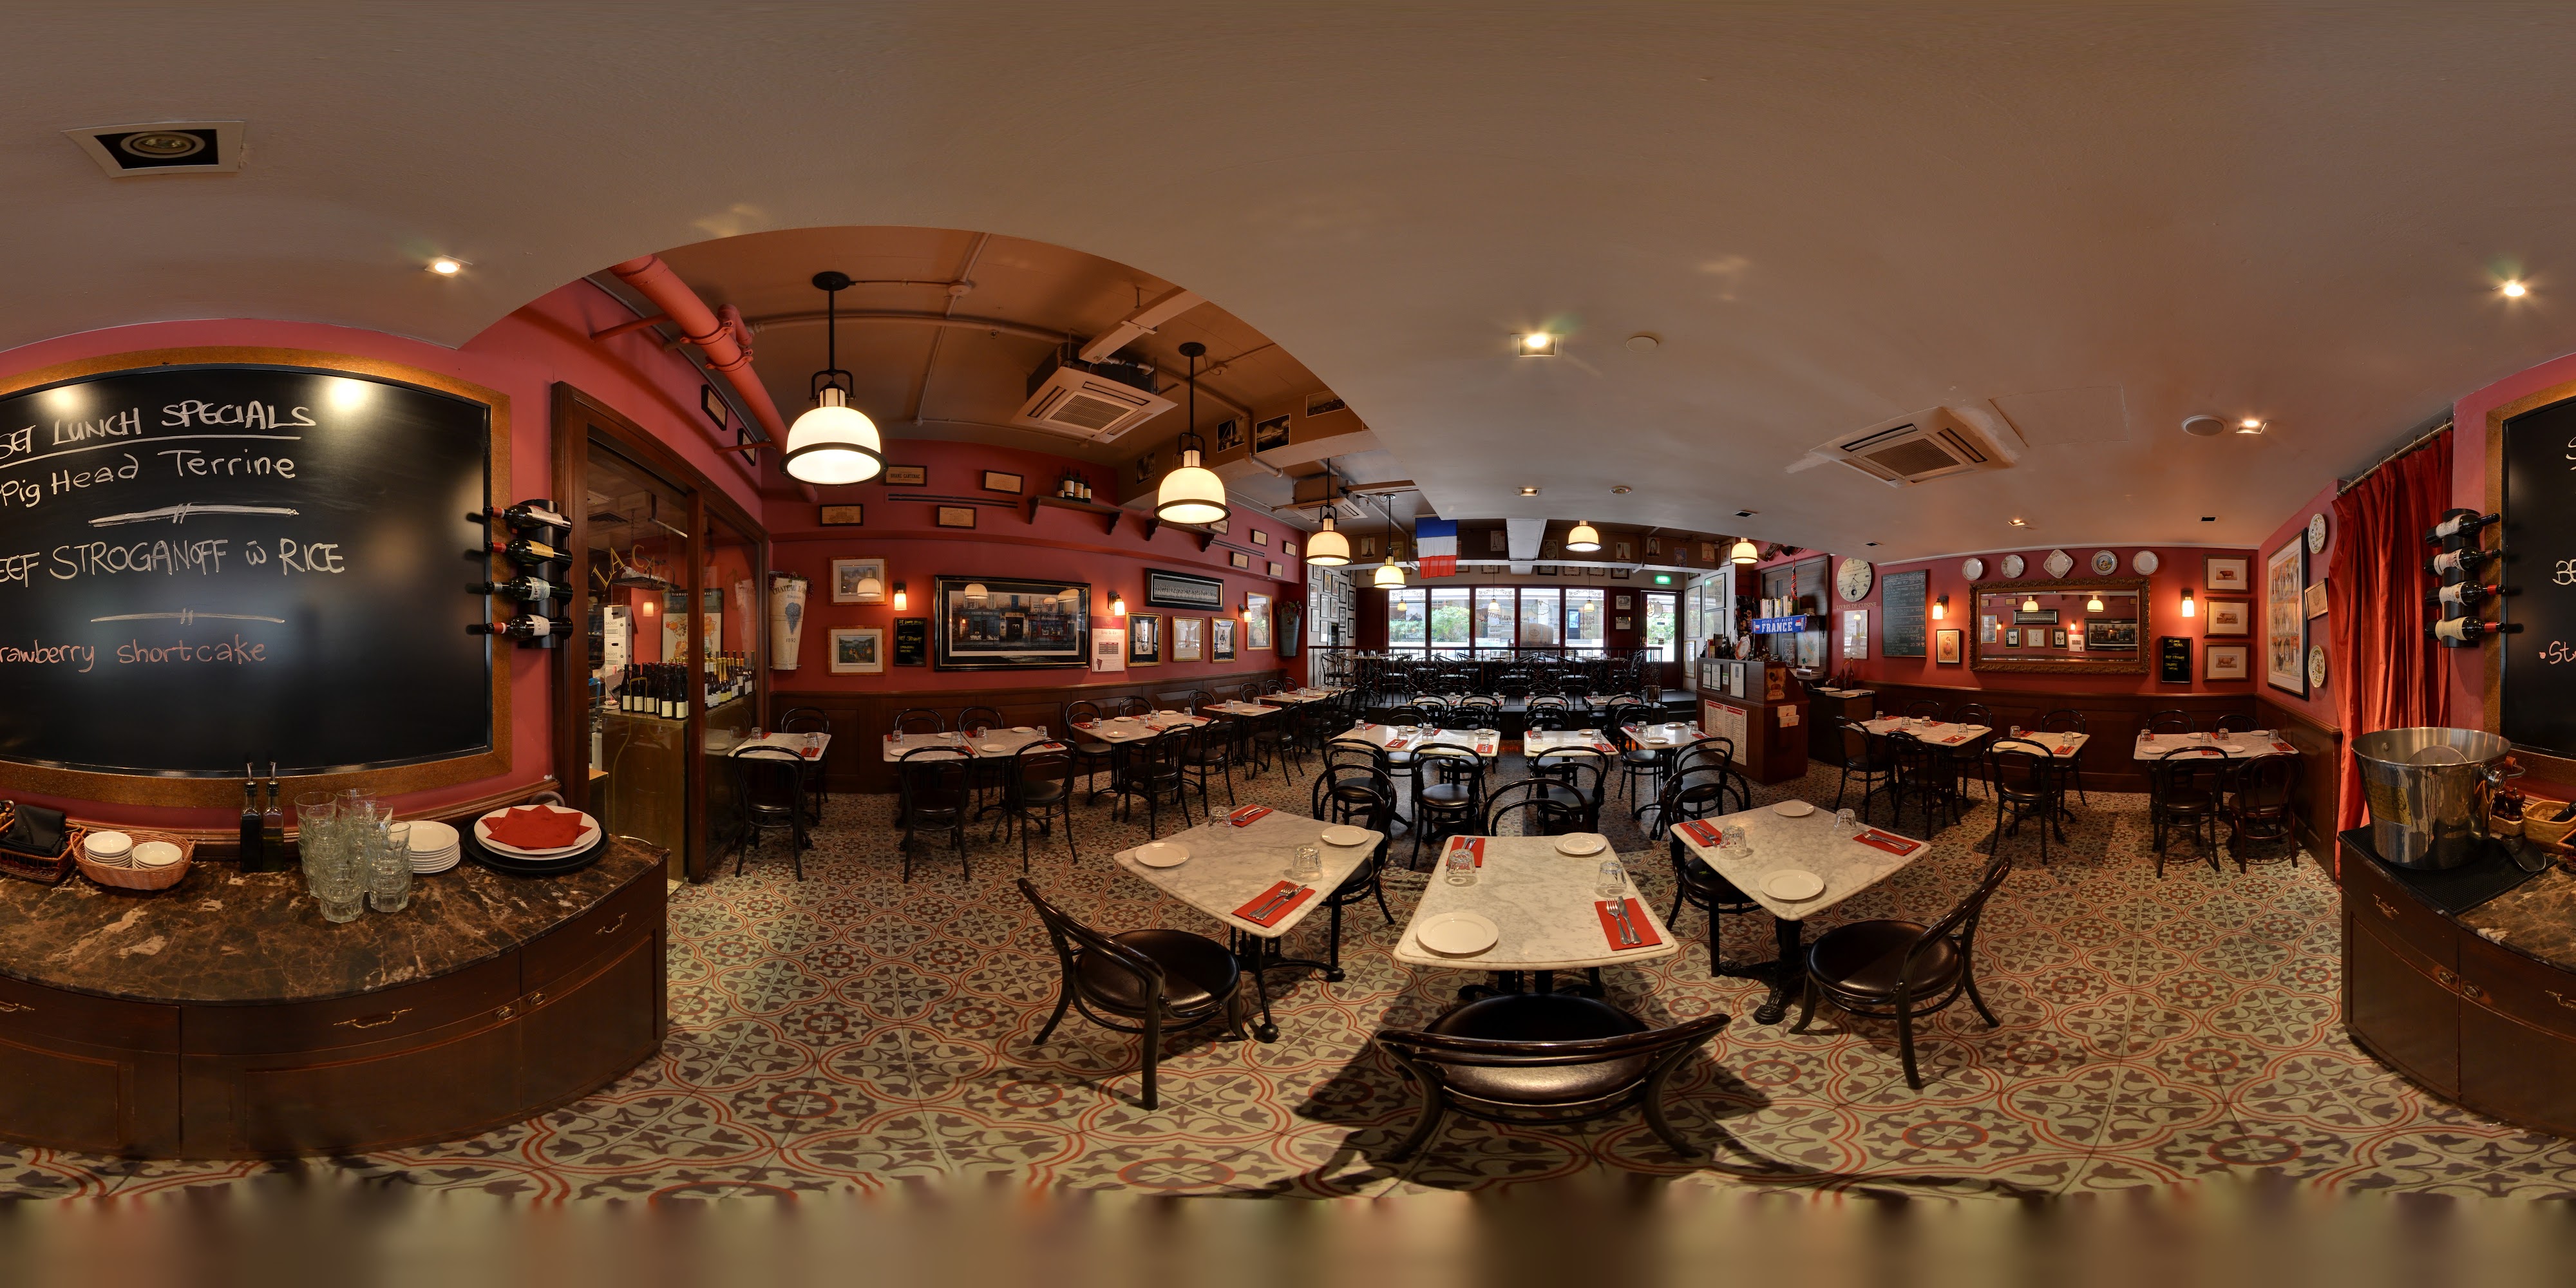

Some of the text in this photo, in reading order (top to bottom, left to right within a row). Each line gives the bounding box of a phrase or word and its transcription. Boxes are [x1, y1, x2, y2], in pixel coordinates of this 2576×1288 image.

[52, 407, 142, 446] LUNCH
[161, 399, 317, 430] SPECIALS
[0, 448, 296, 508] Pig Head Terrine
[50, 540, 228, 580] STROGANOFF
[279, 538, 345, 576] RICE
[592, 547, 625, 591] LA
[1761, 621, 1793, 632] FRANCE
